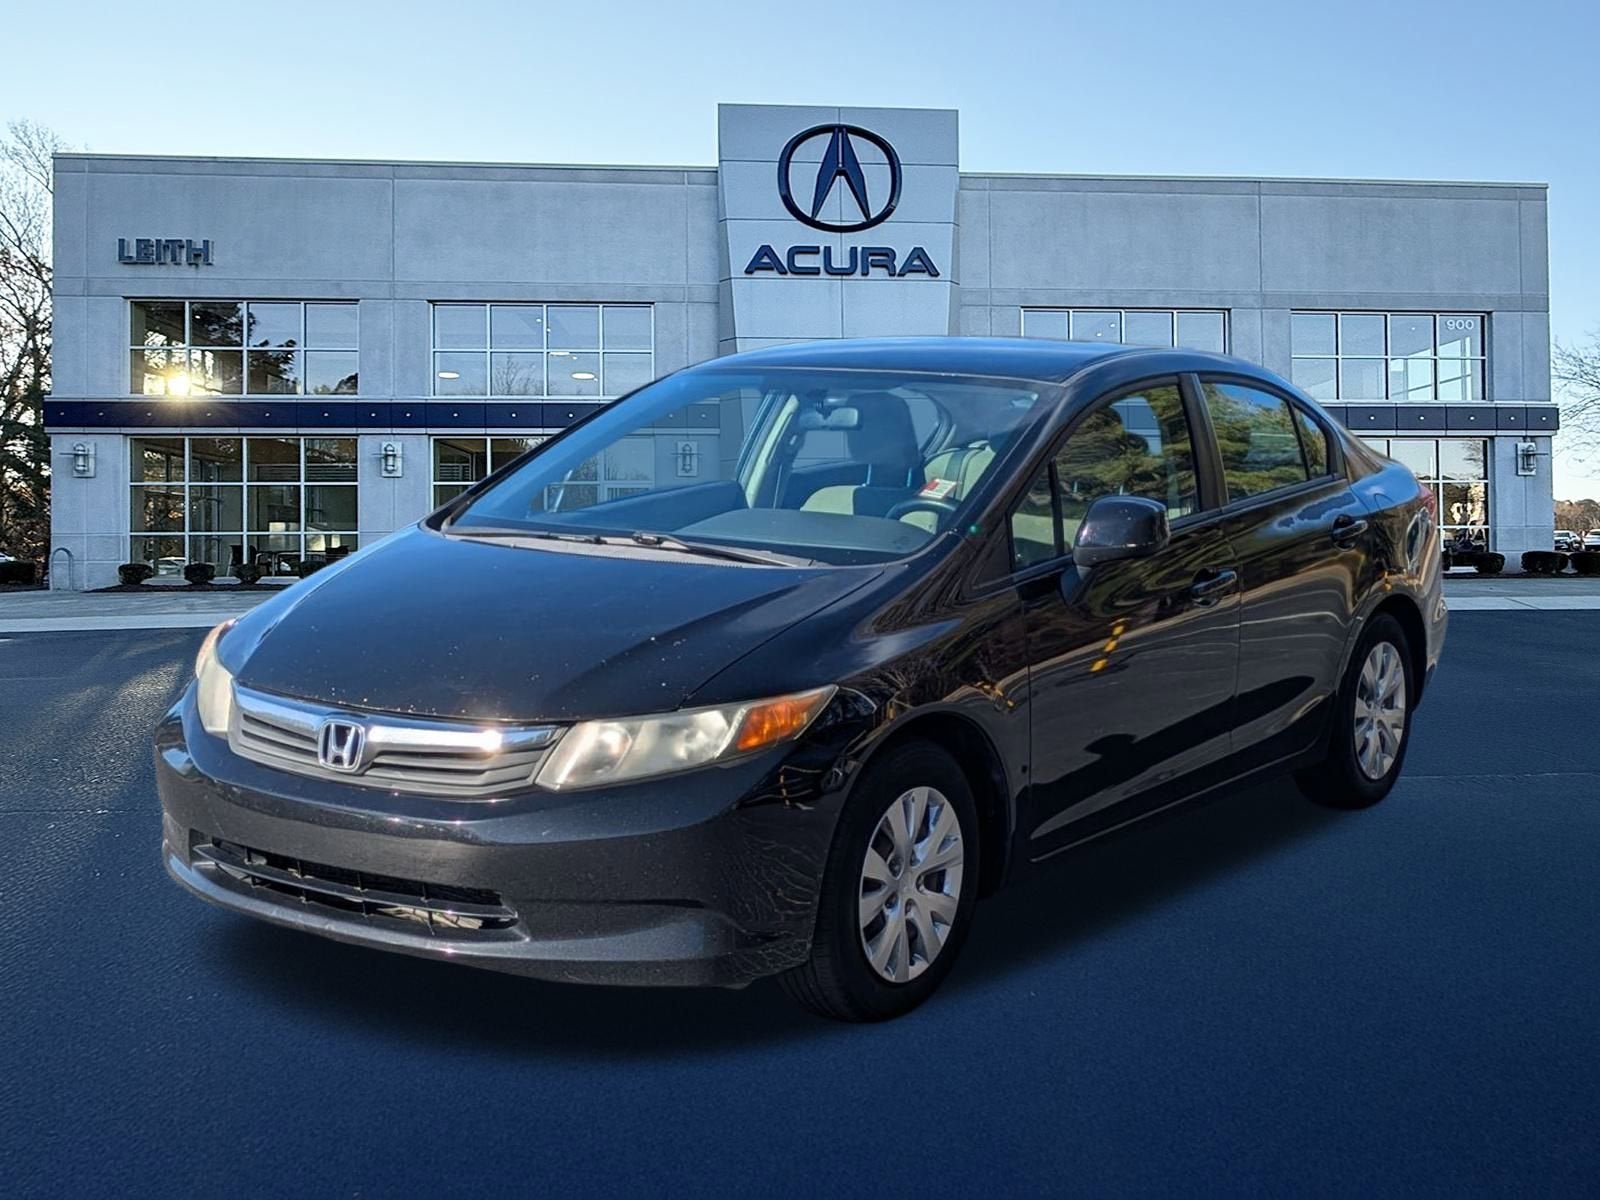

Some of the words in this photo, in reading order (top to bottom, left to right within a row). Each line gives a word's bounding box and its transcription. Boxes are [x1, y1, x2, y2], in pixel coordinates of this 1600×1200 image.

[118, 238, 213, 265] LEITH
[744, 244, 940, 277] ACURA
[1446, 319, 1474, 330] 900
